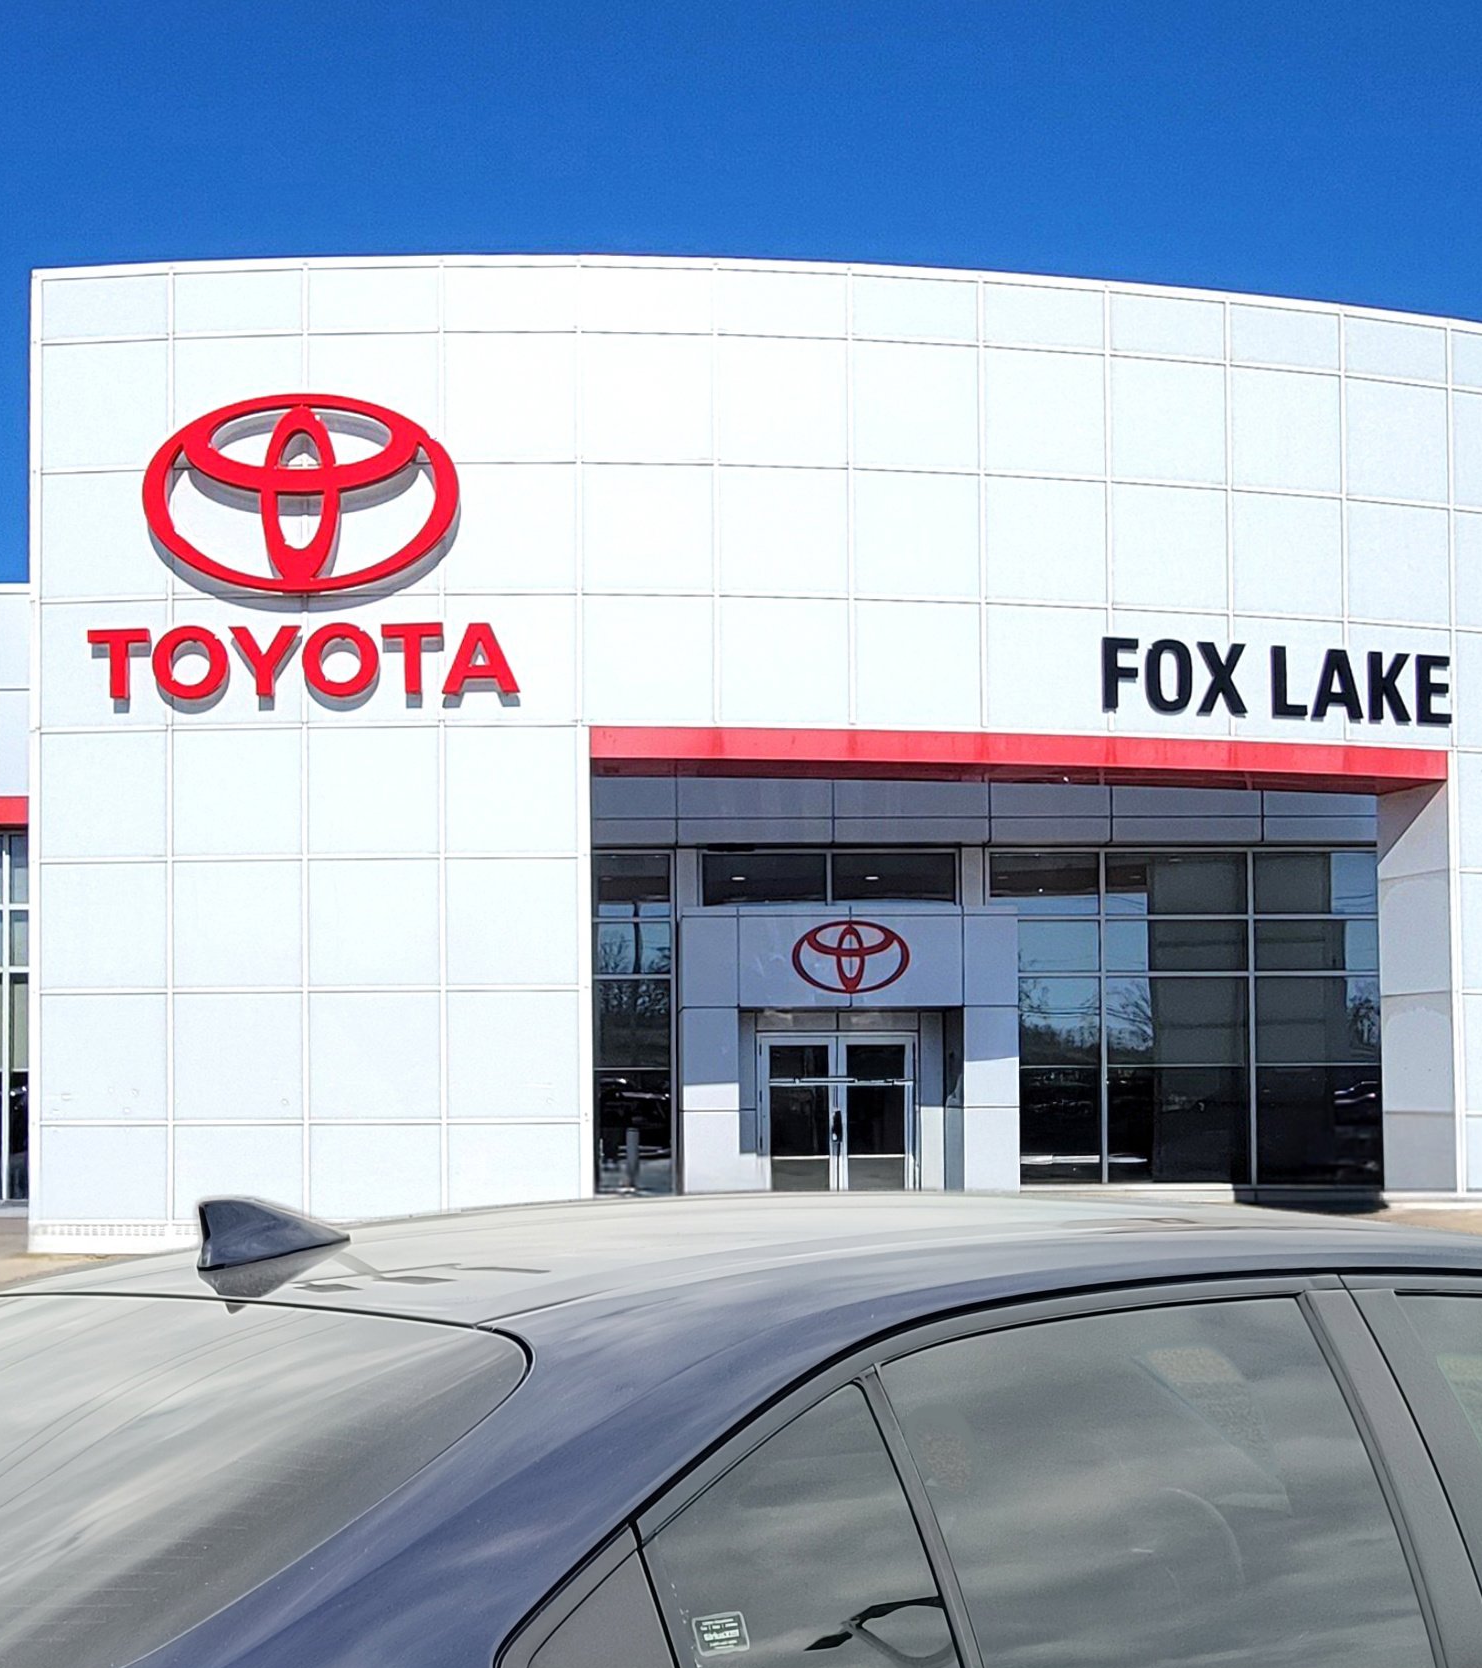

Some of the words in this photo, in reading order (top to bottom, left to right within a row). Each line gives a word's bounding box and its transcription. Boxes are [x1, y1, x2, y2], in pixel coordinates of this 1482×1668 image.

[87, 621, 521, 701] TOYOTA
[1101, 636, 1248, 715] FOX
[1270, 645, 1452, 725] LAKE
